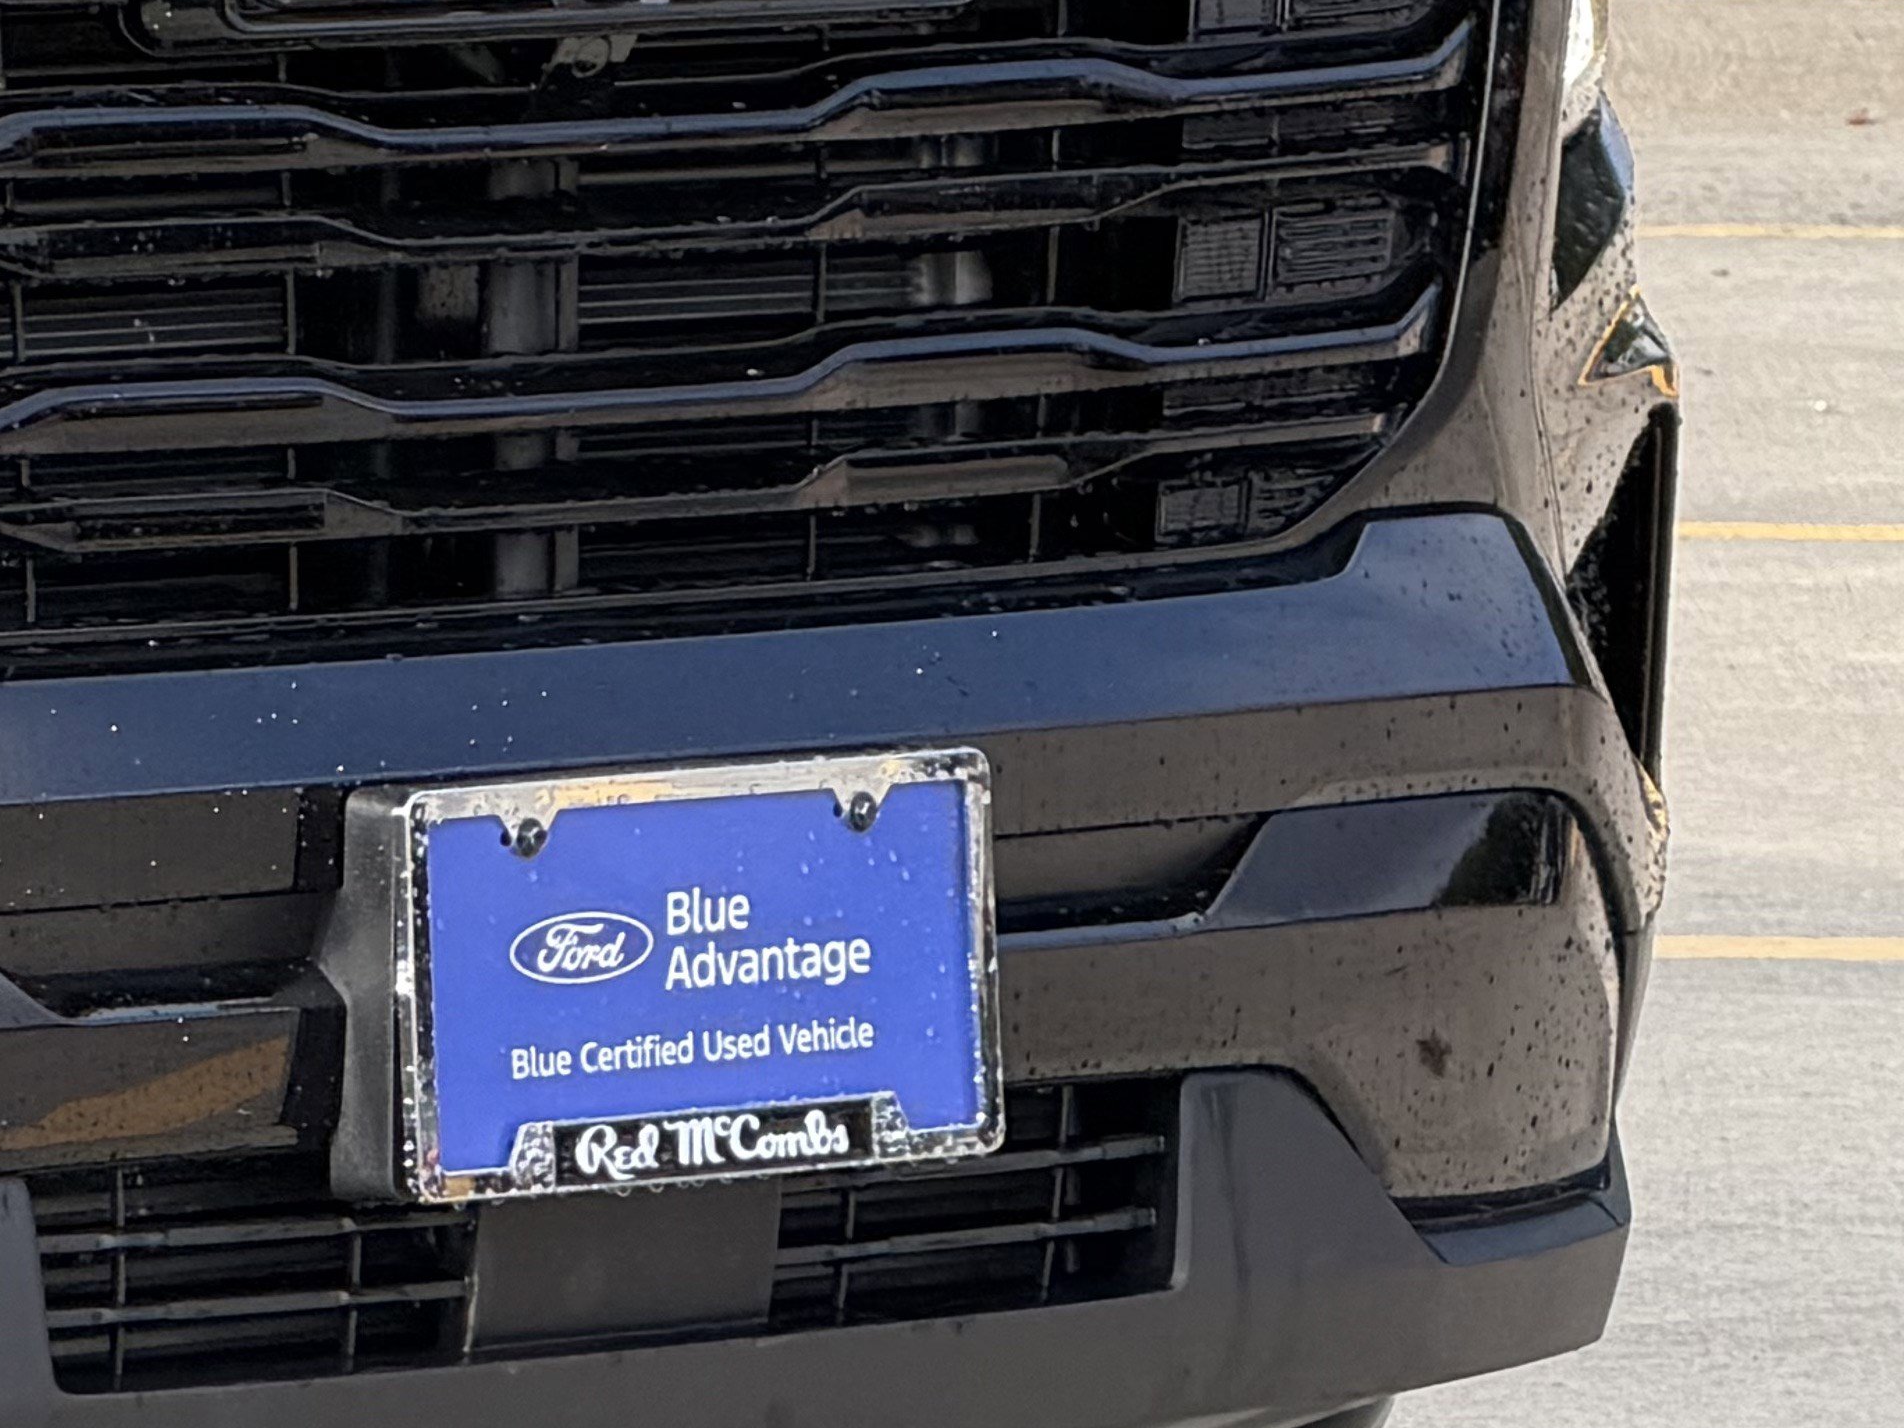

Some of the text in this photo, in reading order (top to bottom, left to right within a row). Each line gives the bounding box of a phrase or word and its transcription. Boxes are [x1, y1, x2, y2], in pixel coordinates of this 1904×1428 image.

[666, 887, 750, 936] Blue
[537, 923, 626, 973] Ford
[665, 936, 872, 990] Advantage
[511, 1016, 875, 1080] Blue Certified Used Vehicle
[574, 1109, 850, 1181] Red McCombs
